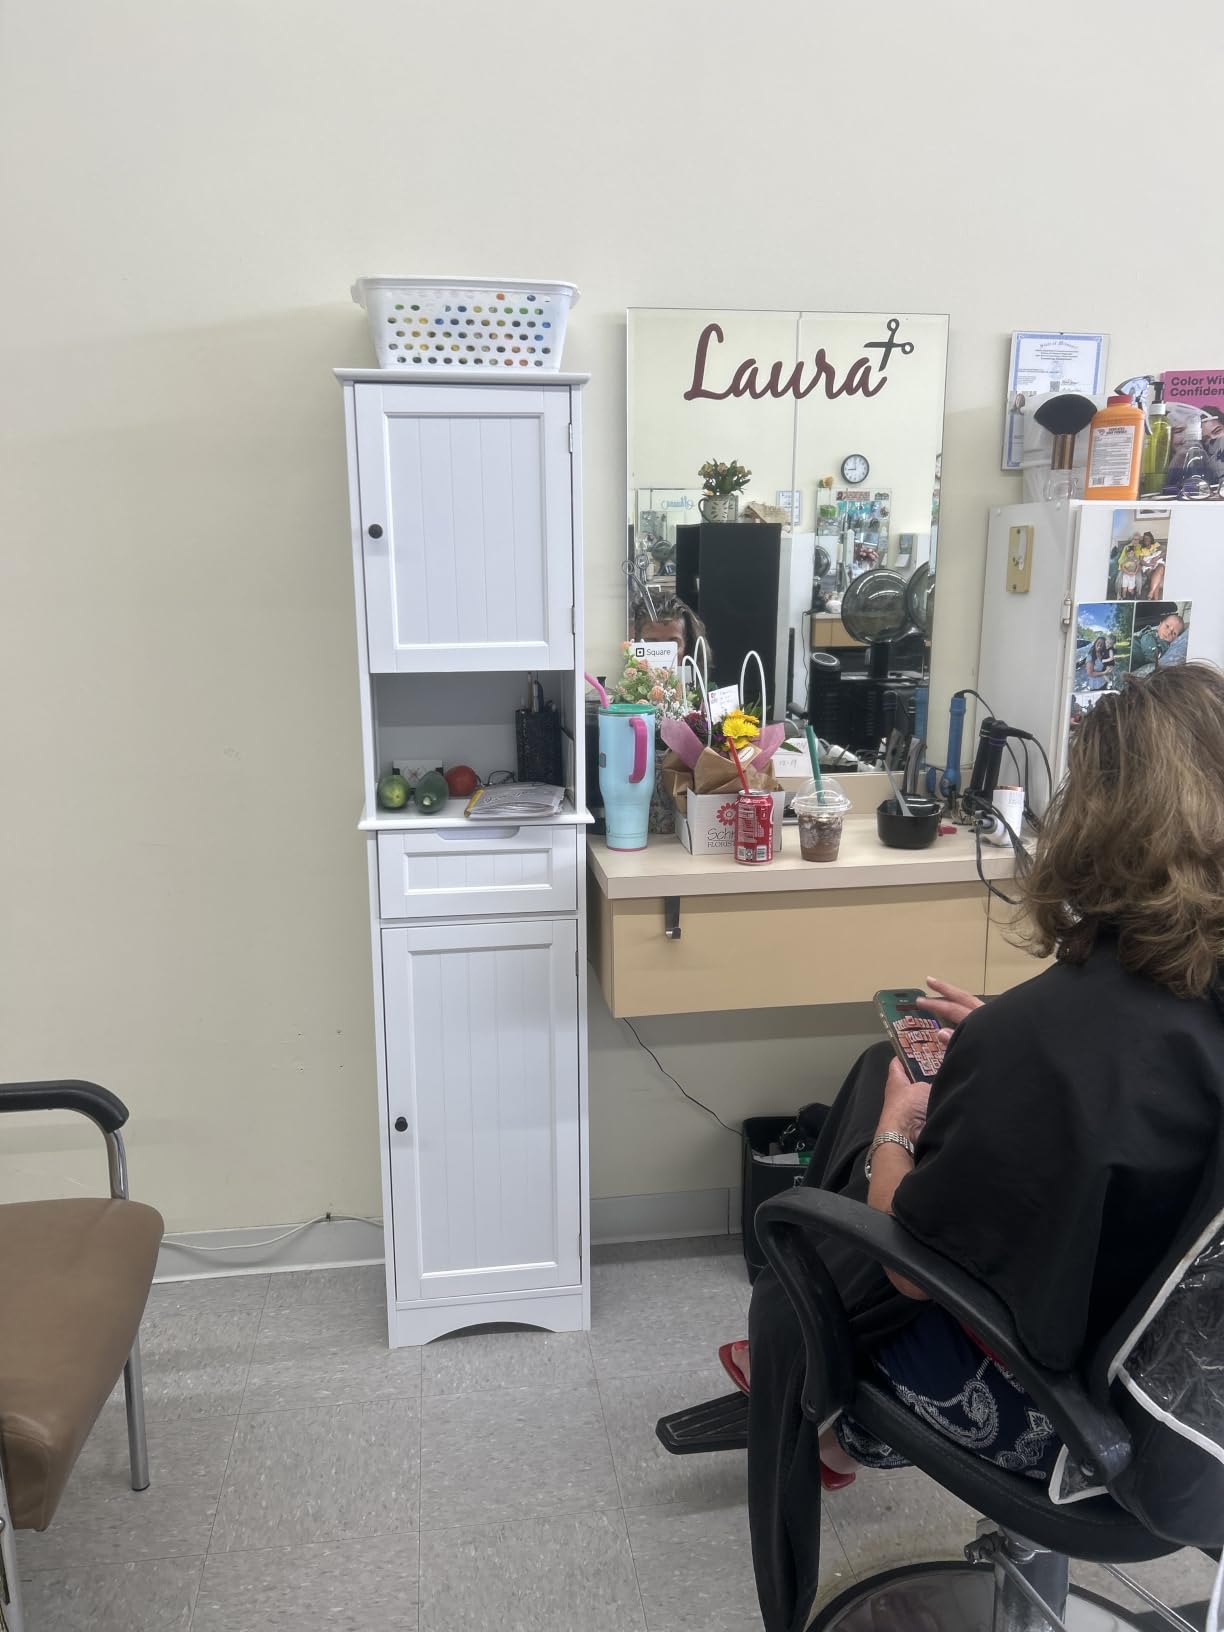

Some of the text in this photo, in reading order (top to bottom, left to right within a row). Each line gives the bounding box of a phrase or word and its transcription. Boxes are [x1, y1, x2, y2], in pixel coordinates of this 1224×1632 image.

[683, 322, 888, 401] Laura
[1171, 376, 1205, 386] Color
[646, 648, 671, 657] Square
